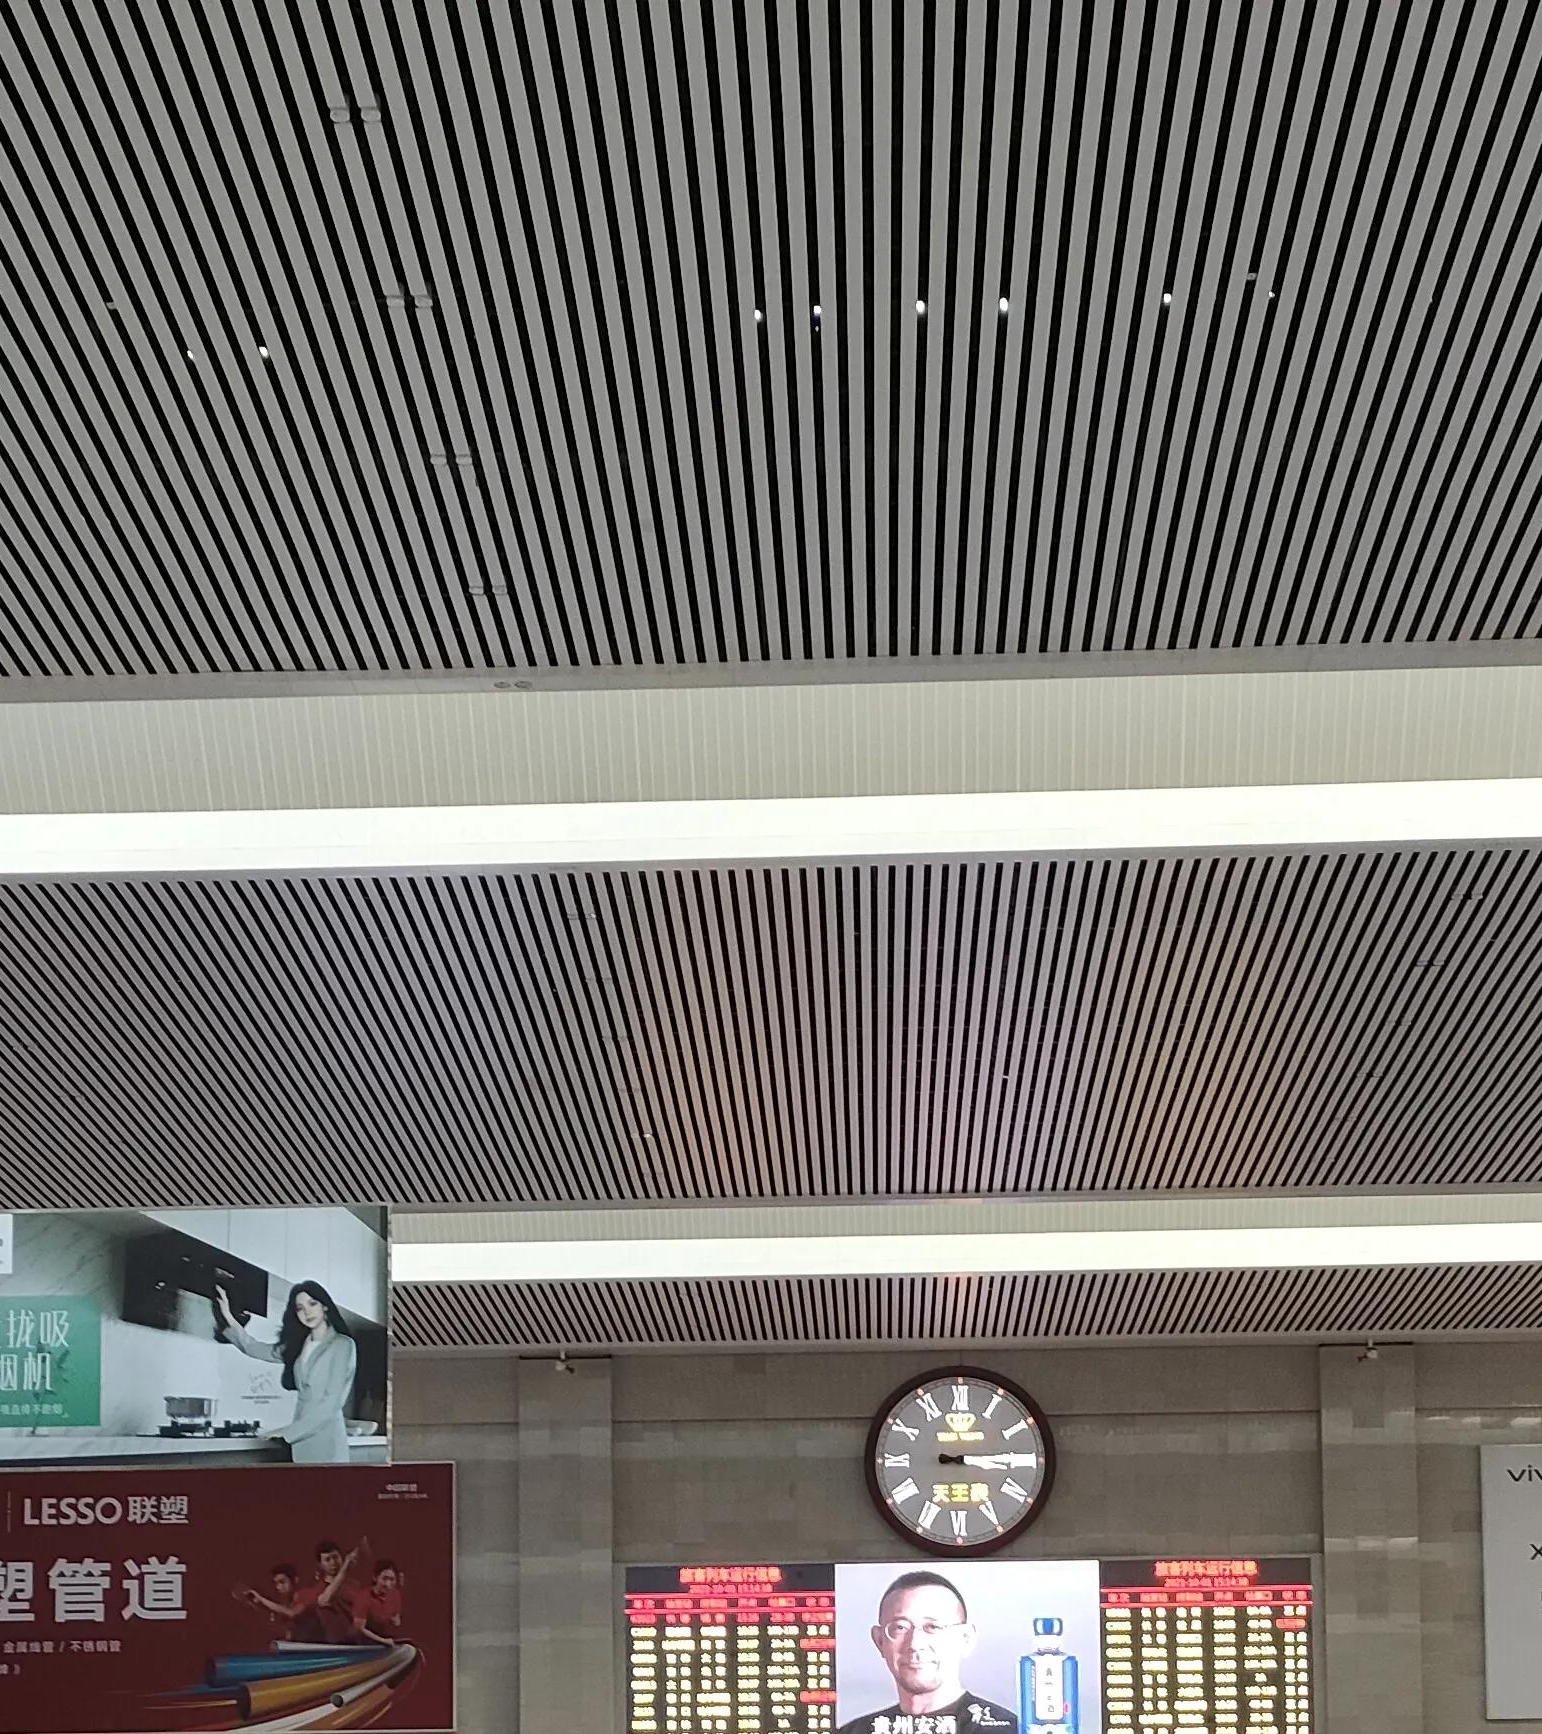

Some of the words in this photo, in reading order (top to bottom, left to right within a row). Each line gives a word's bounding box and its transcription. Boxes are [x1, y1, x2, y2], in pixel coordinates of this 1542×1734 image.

[891, 1418, 920, 1441] X
[23, 1497, 122, 1526] LESSO
[127, 1495, 189, 1525] 联塑
